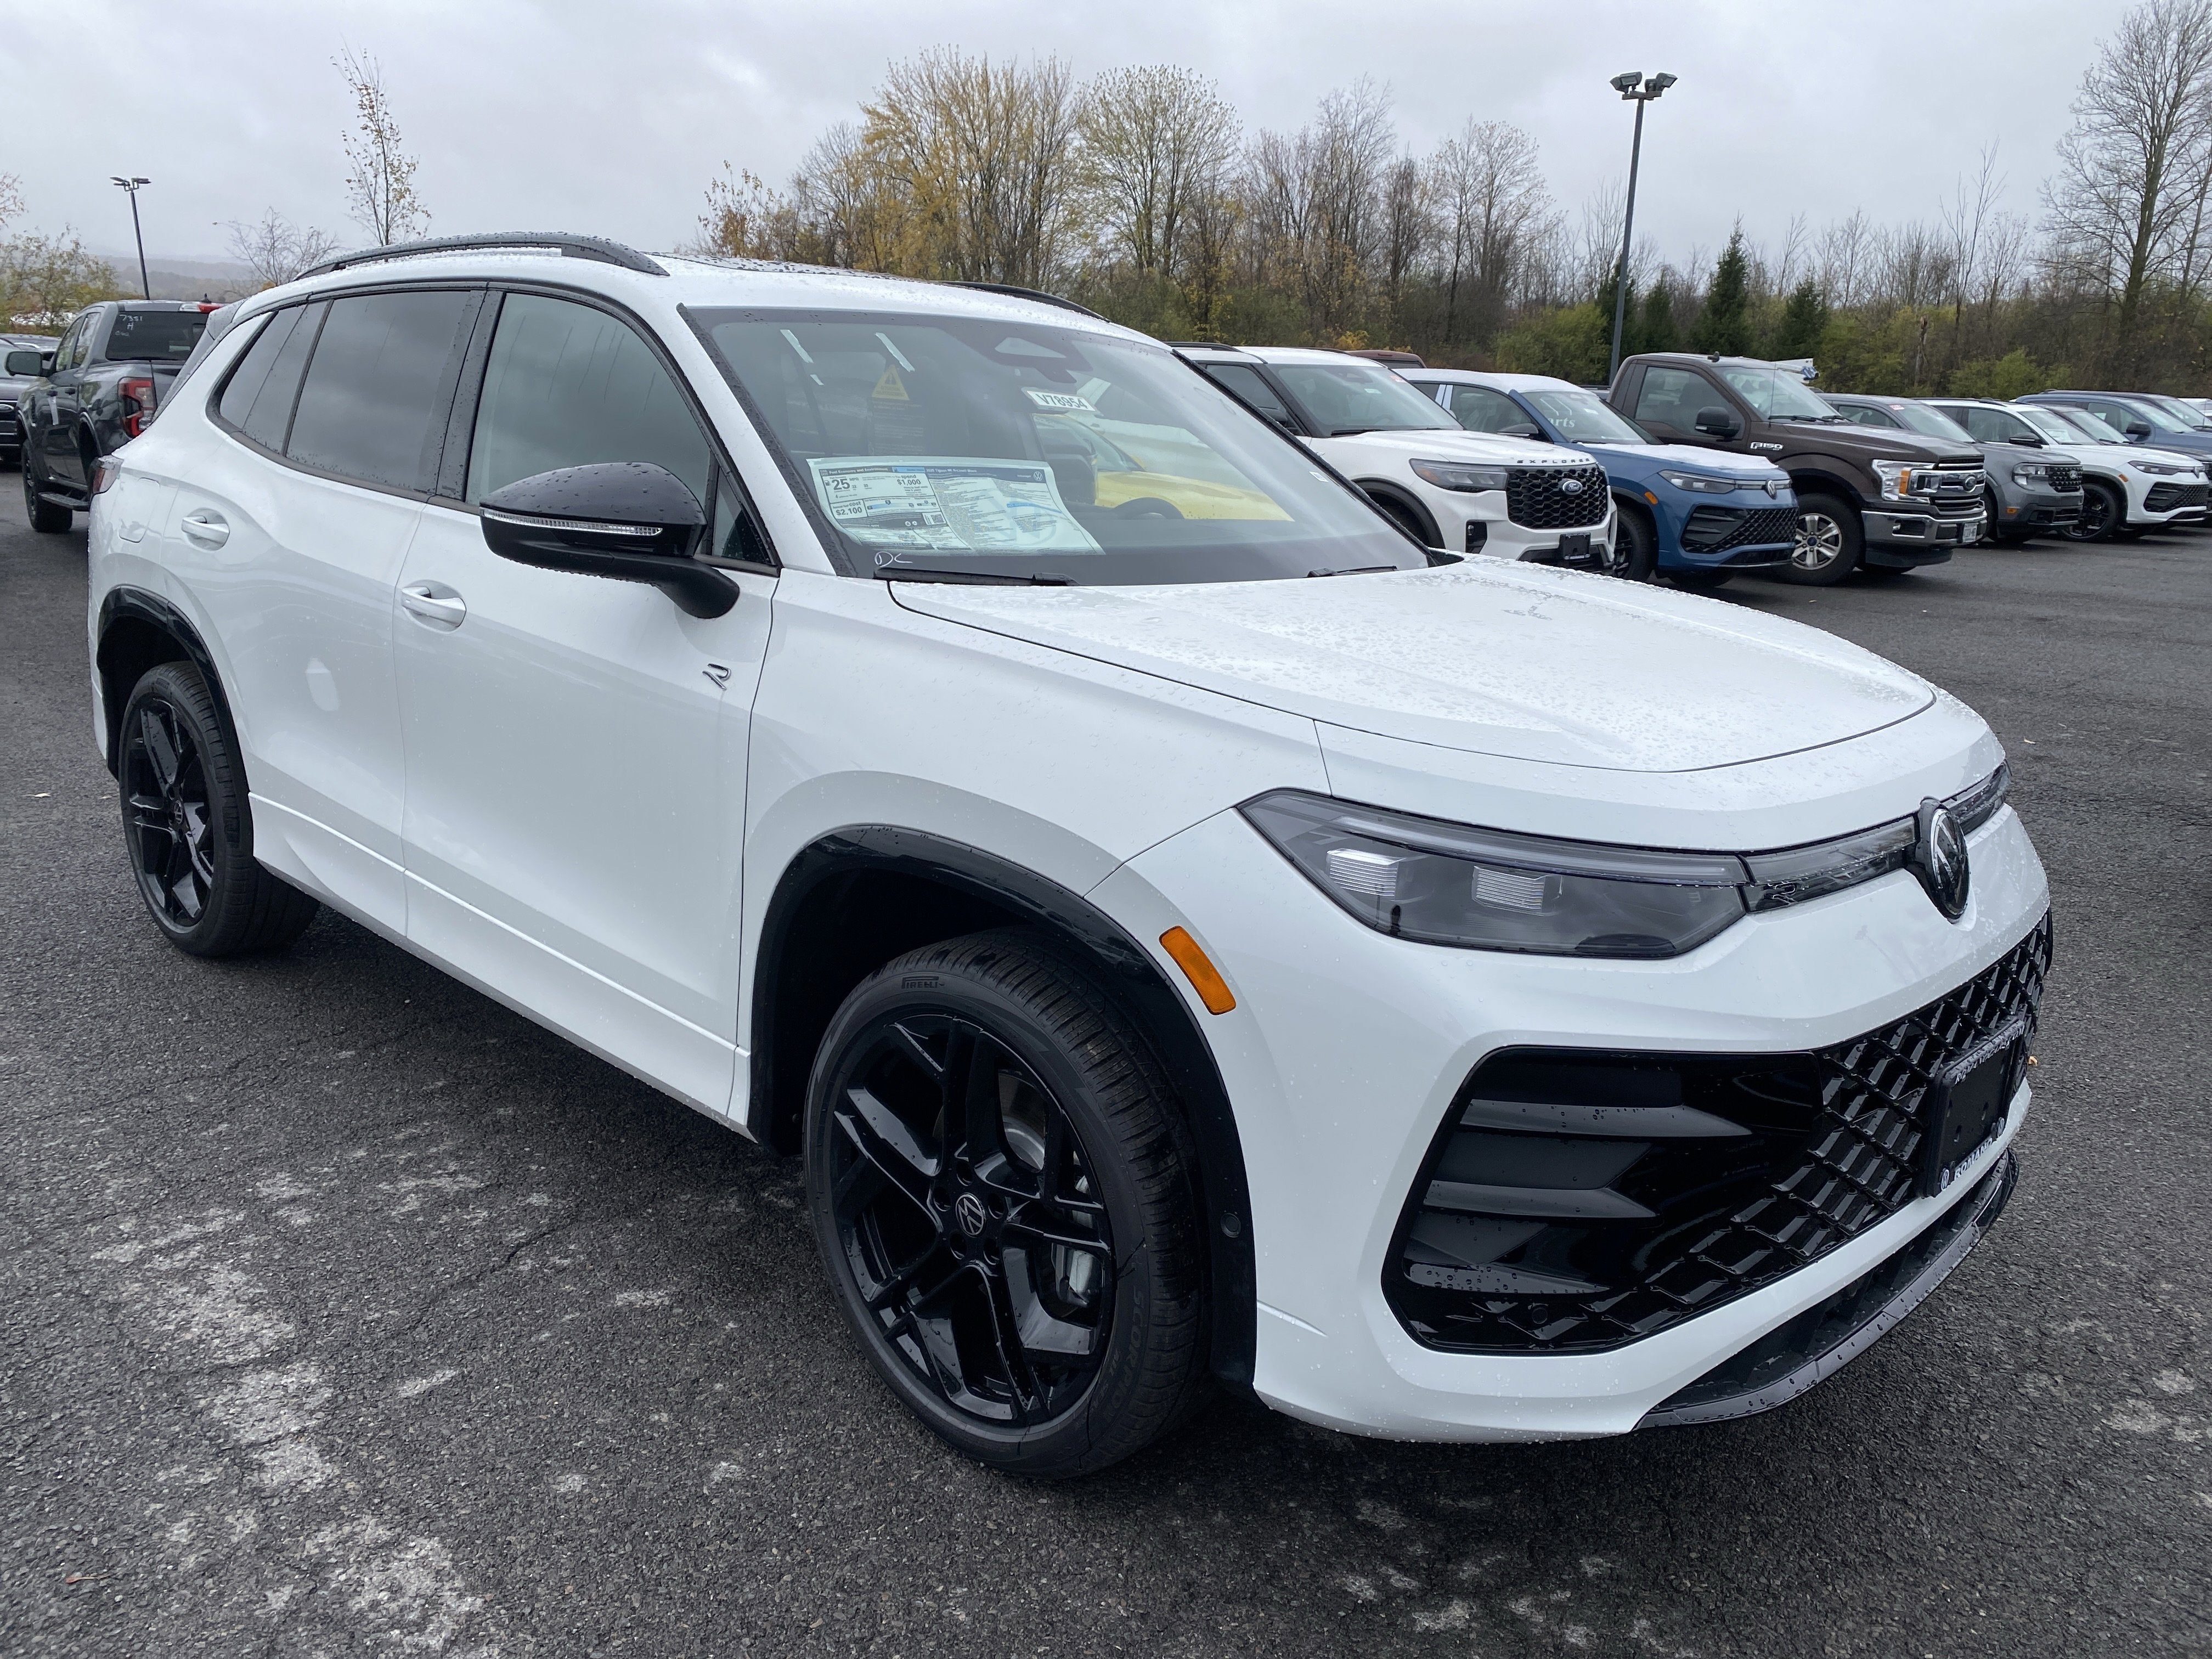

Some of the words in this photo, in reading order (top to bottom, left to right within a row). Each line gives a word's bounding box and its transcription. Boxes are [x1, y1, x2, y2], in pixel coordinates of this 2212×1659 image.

[1035, 393, 1088, 409] V78954
[832, 478, 850, 490] 25
[836, 506, 862, 516] $2,100
[901, 976, 940, 989] PIRELLI
[1954, 1137, 1993, 1181] ROMANO
